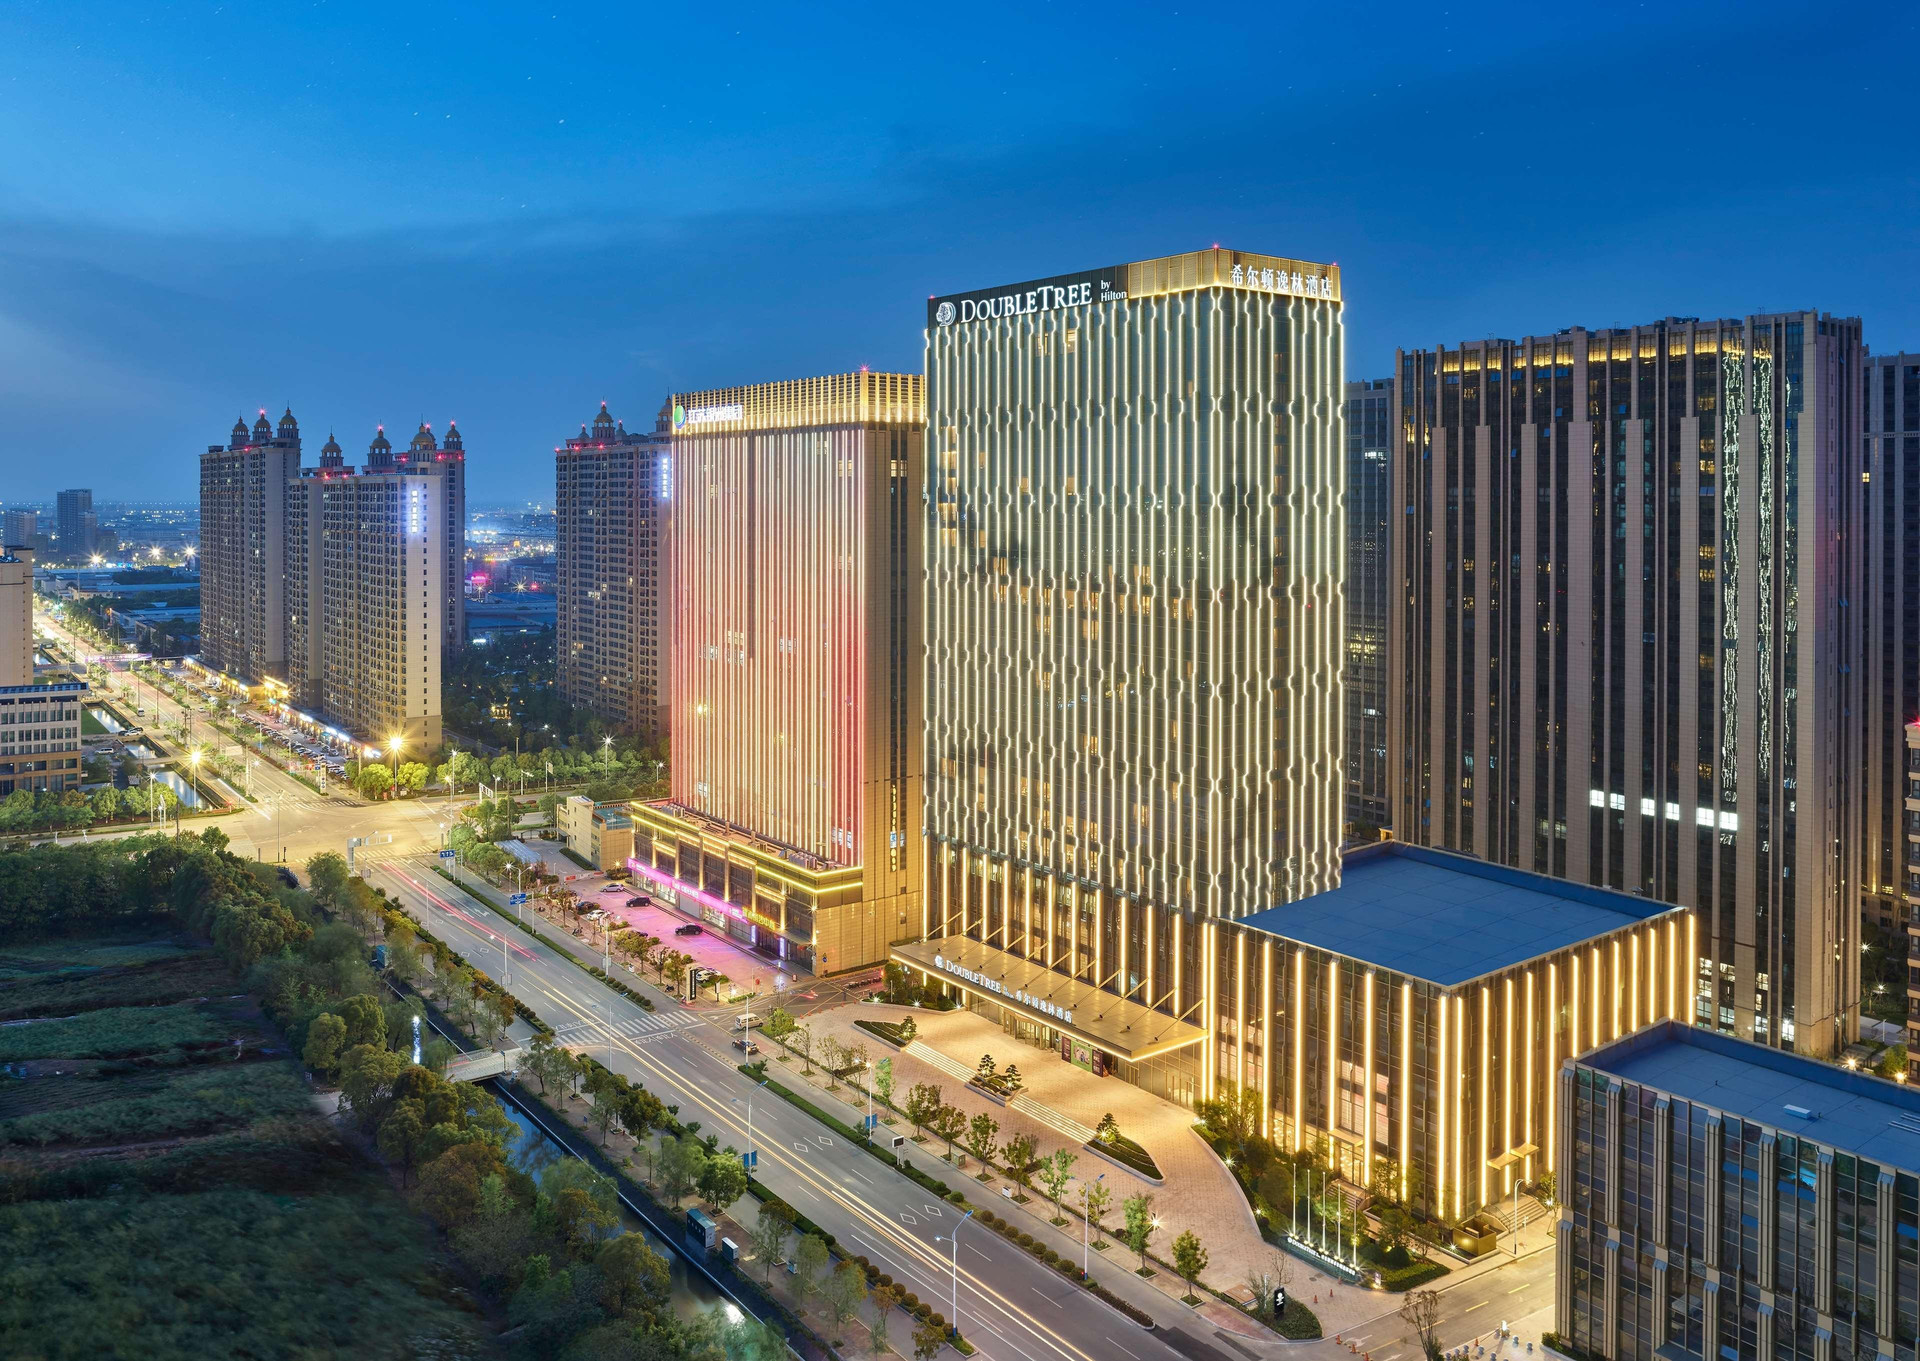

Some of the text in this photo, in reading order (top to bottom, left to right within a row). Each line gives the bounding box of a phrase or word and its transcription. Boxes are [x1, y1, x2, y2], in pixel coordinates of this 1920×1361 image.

[1101, 280, 1111, 291] by
[1101, 291, 1127, 302] Hilton
[1230, 264, 1332, 299] 希尔顿逸林酒店
[961, 282, 1092, 323] DOUBLETREE
[946, 960, 1001, 993] DOUBLETREE
